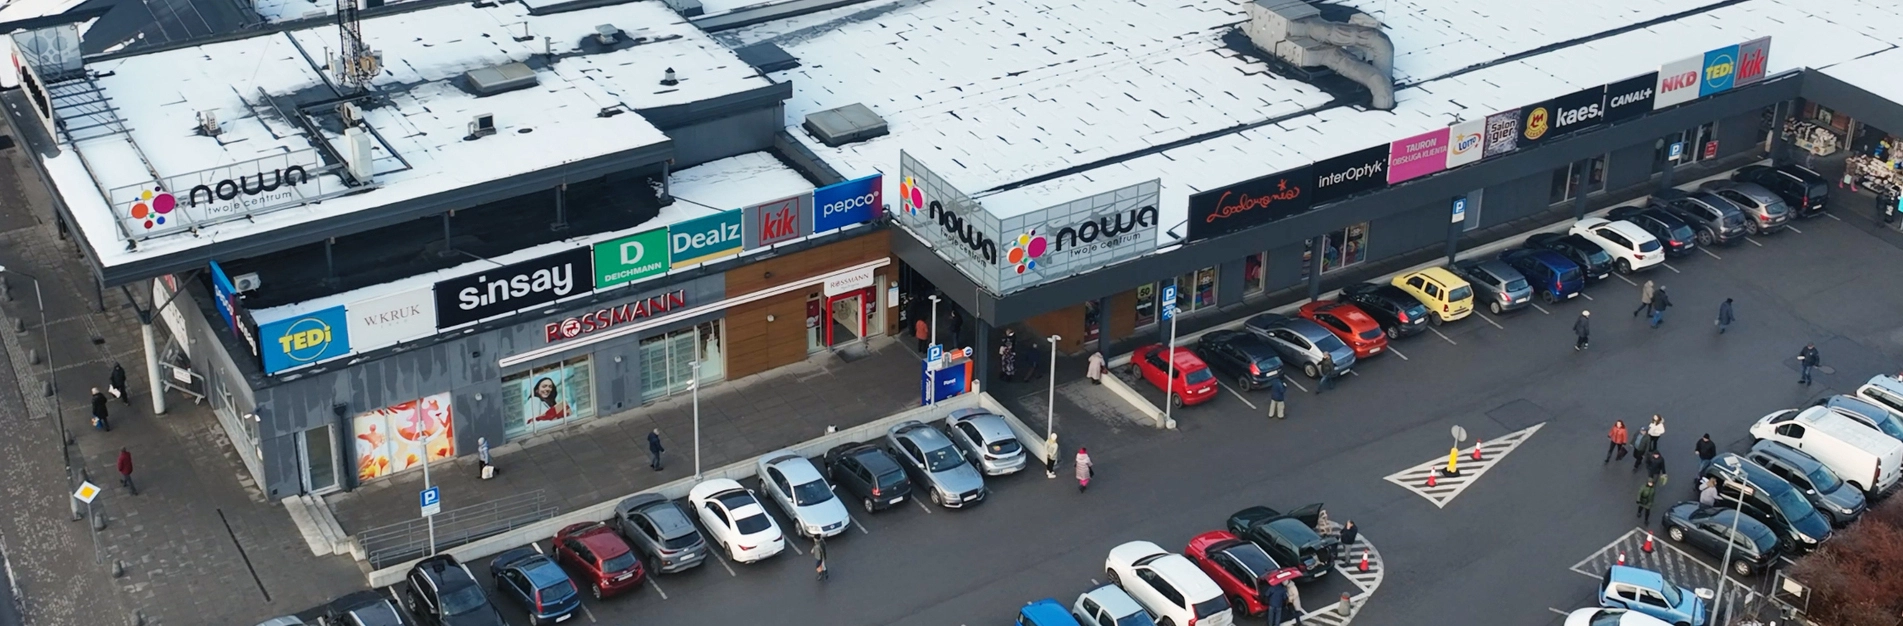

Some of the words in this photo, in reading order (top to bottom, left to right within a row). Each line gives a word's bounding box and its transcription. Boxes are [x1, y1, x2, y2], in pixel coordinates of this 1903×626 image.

[1706, 62, 1733, 80] TEDi
[1738, 49, 1765, 79] kik
[1661, 71, 1697, 93] NKD
[1610, 87, 1652, 108] CANAL+
[1491, 120, 1515, 133] Salon
[1492, 128, 1513, 144] gier
[1406, 137, 1437, 153] TAURON
[1421, 145, 1447, 158] KLIENTA
[1458, 136, 1477, 151] LOTTO
[1318, 160, 1382, 188] interOptyk
[190, 165, 307, 208] nowa
[208, 202, 240, 214] twoje
[244, 190, 292, 207] centrum
[763, 203, 796, 240] kik
[930, 200, 996, 265] nowa
[1056, 205, 1158, 251] nowa
[673, 222, 740, 254] Dealz
[1070, 244, 1098, 258] twoje
[1100, 232, 1141, 250] centrum
[620, 241, 644, 265] D
[604, 262, 662, 281] DEICHMANN
[830, 273, 869, 288] ROSSMANN
[459, 263, 573, 310] sinsay
[545, 289, 685, 343] ROSSMANN
[279, 325, 332, 353] TEDi
